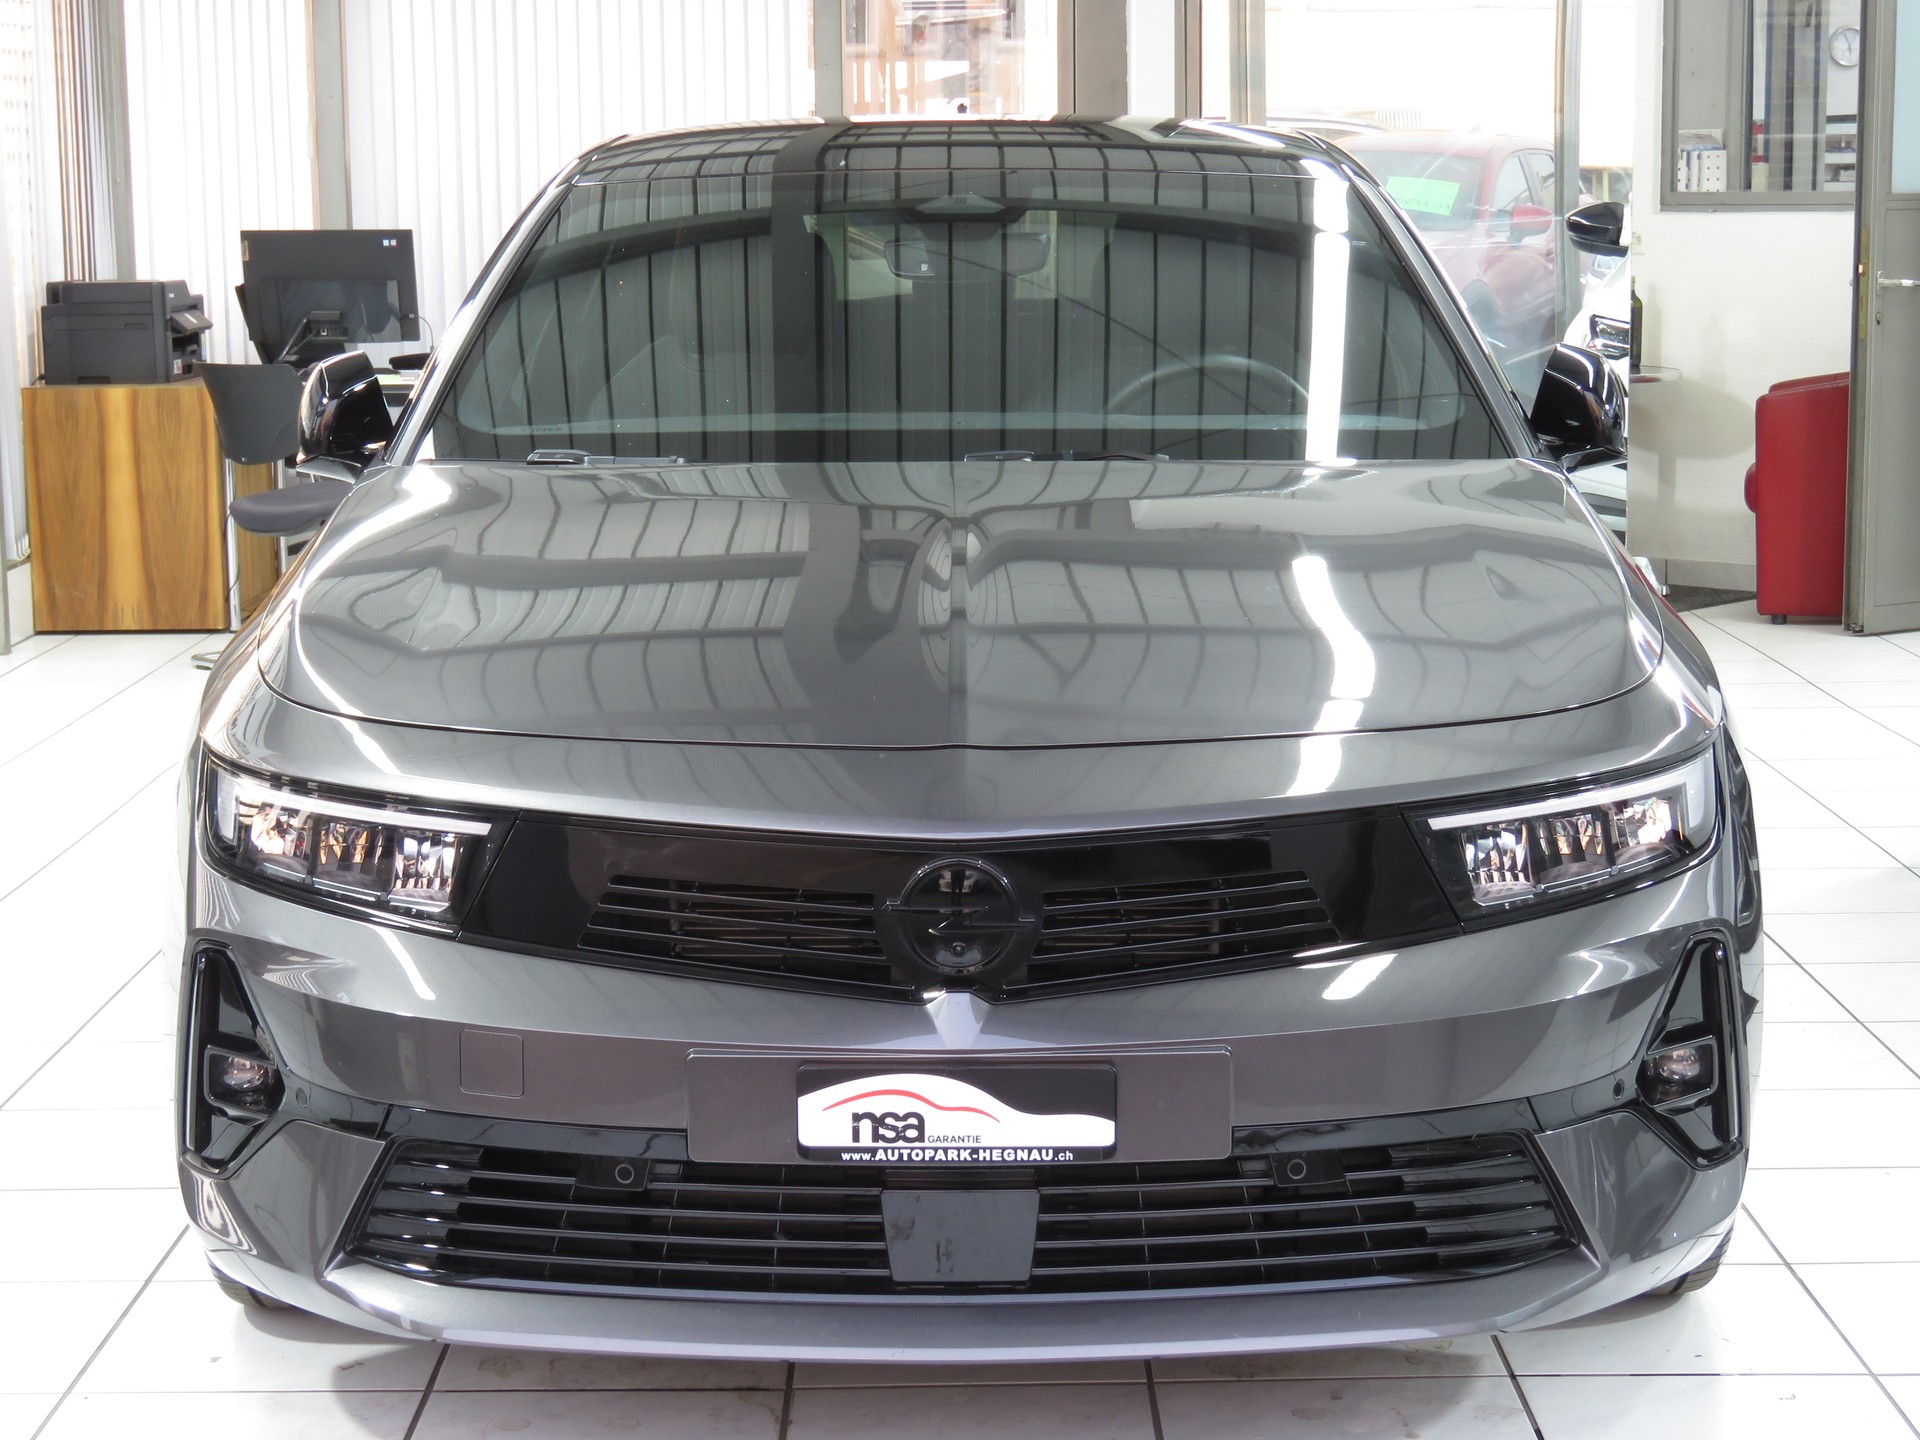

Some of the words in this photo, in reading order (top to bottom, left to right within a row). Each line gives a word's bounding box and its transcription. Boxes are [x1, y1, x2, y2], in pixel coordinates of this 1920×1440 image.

[851, 1111, 925, 1144] nsa
[927, 1134, 982, 1144] GARANTIE
[841, 1148, 1074, 1161] www.AUTOPARK-HEGNAU.ch
